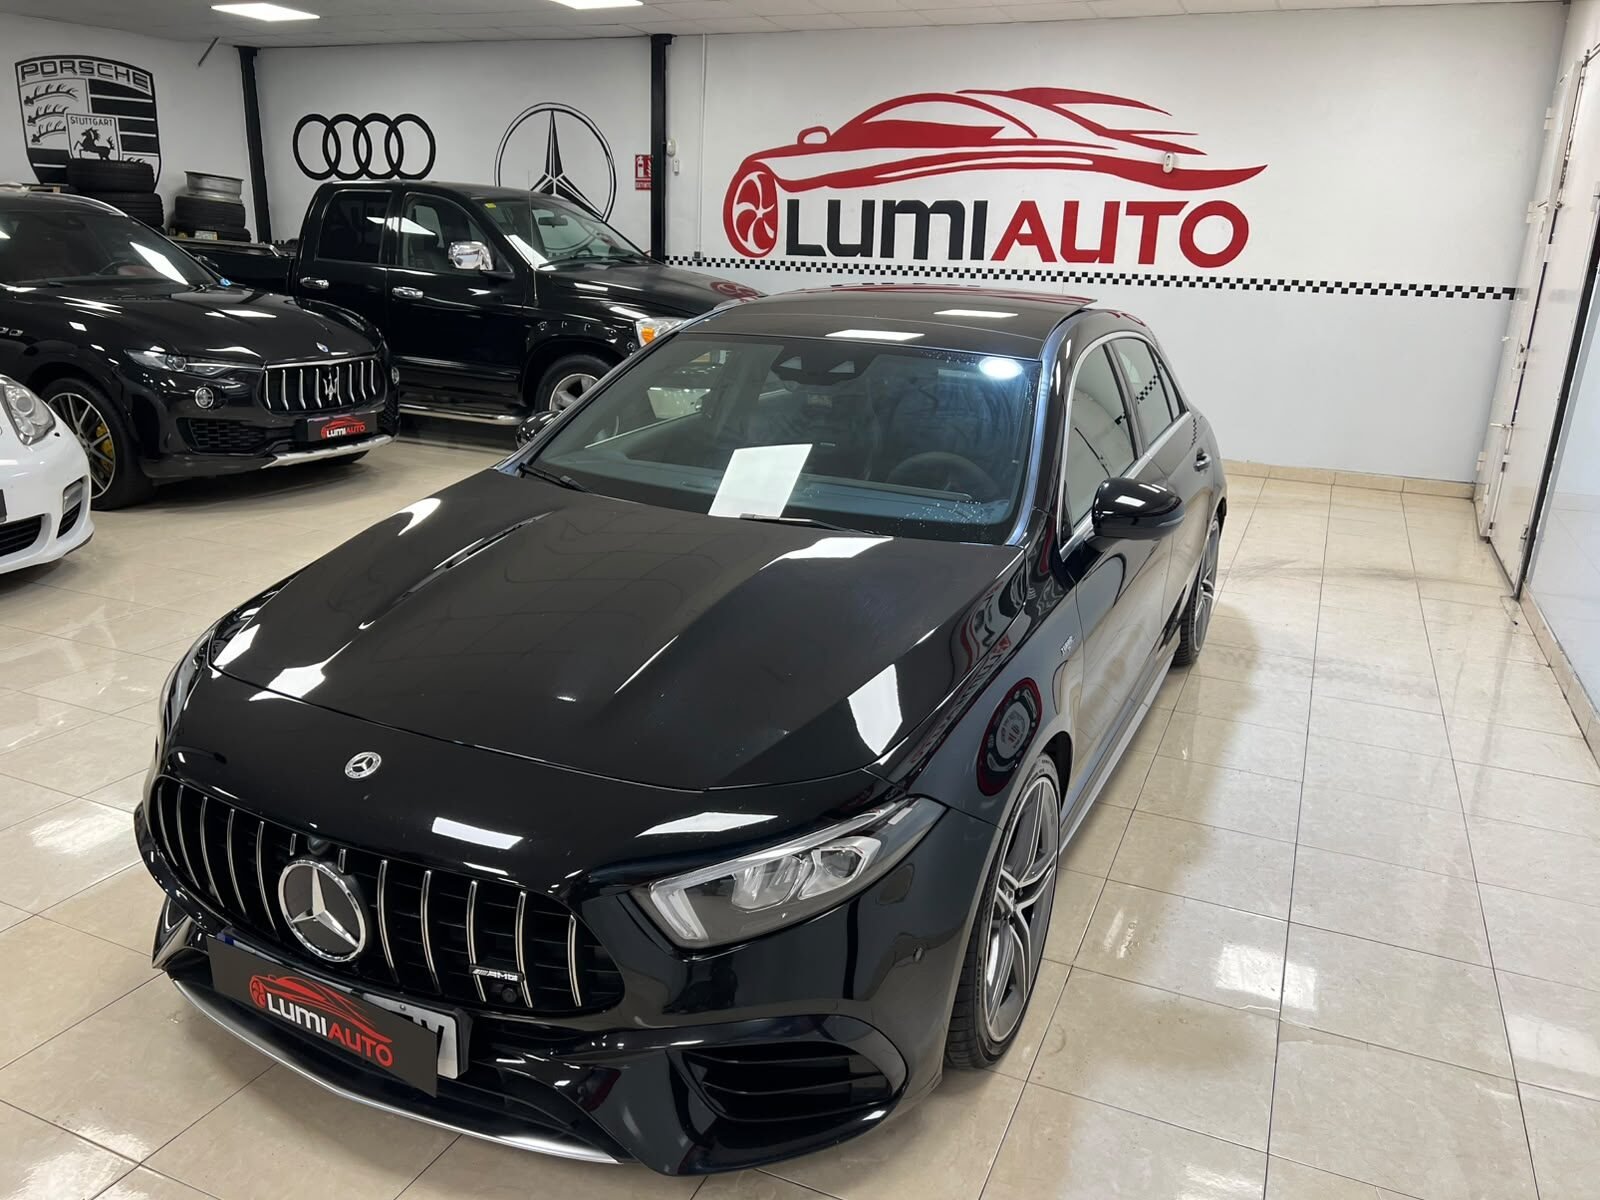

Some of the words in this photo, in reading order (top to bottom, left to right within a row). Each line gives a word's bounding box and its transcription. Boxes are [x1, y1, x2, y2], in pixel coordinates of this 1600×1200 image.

[21, 60, 149, 90] PORSCHE
[70, 116, 113, 126] STUTTGART
[786, 198, 1249, 268] LUMIAUTO
[267, 993, 393, 1067] LUMIAUTO
